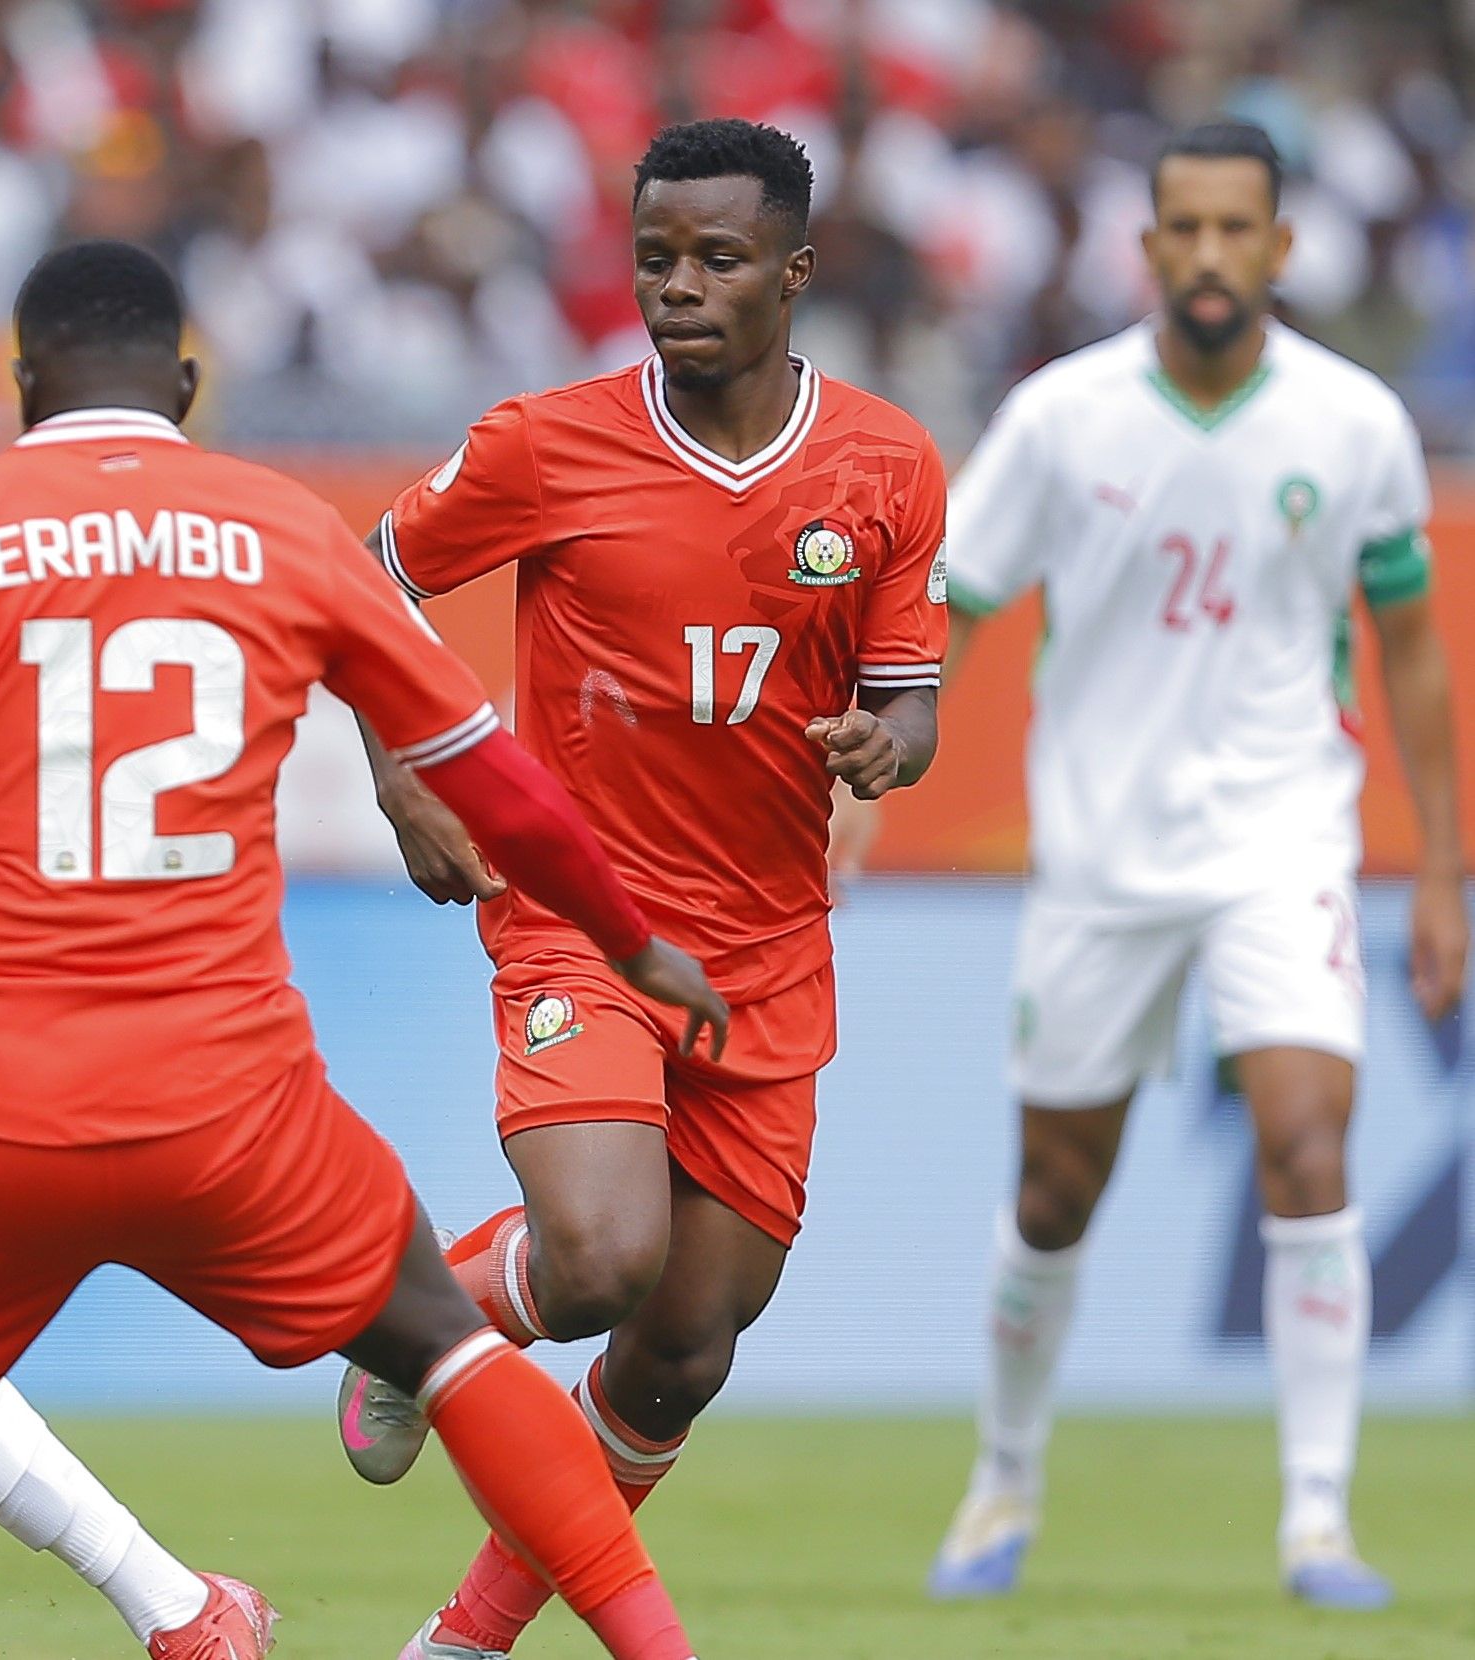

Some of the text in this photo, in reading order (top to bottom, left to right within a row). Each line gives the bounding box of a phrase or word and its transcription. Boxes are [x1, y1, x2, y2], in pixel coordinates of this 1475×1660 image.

[797, 529, 812, 570] FOOTBALL
[801, 574, 849, 585] FEDERATION
[1160, 533, 1236, 632] 24
[684, 625, 781, 725] 17
[20, 617, 245, 881] 12
